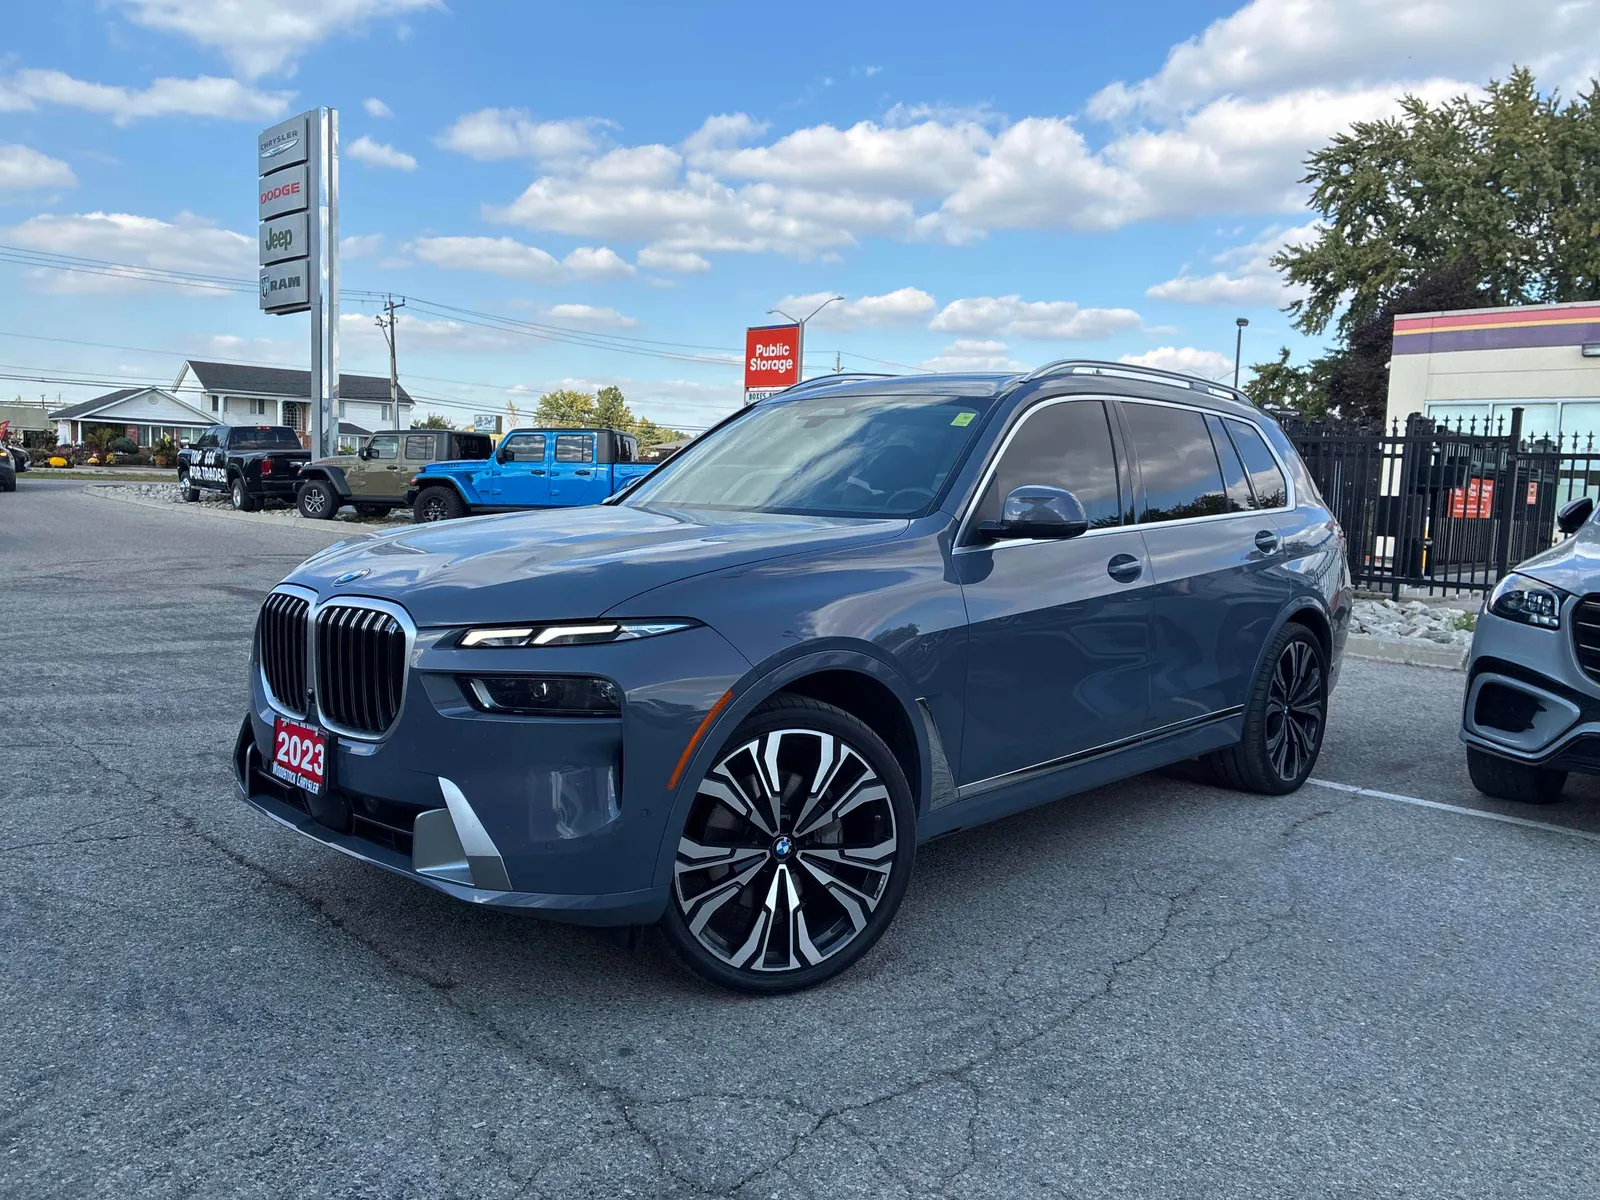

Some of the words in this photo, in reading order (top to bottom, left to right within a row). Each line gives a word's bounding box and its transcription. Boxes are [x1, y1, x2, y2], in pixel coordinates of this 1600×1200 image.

[260, 130, 299, 151] CHRYSLER
[260, 182, 300, 205] DODGE
[265, 227, 293, 251] Jeep
[270, 275, 301, 292] RAM
[755, 343, 790, 357] Public
[750, 358, 793, 373] Storage
[189, 465, 203, 480] FOR
[277, 731, 325, 776] 2023
[296, 772, 320, 795] CHRYSLER
